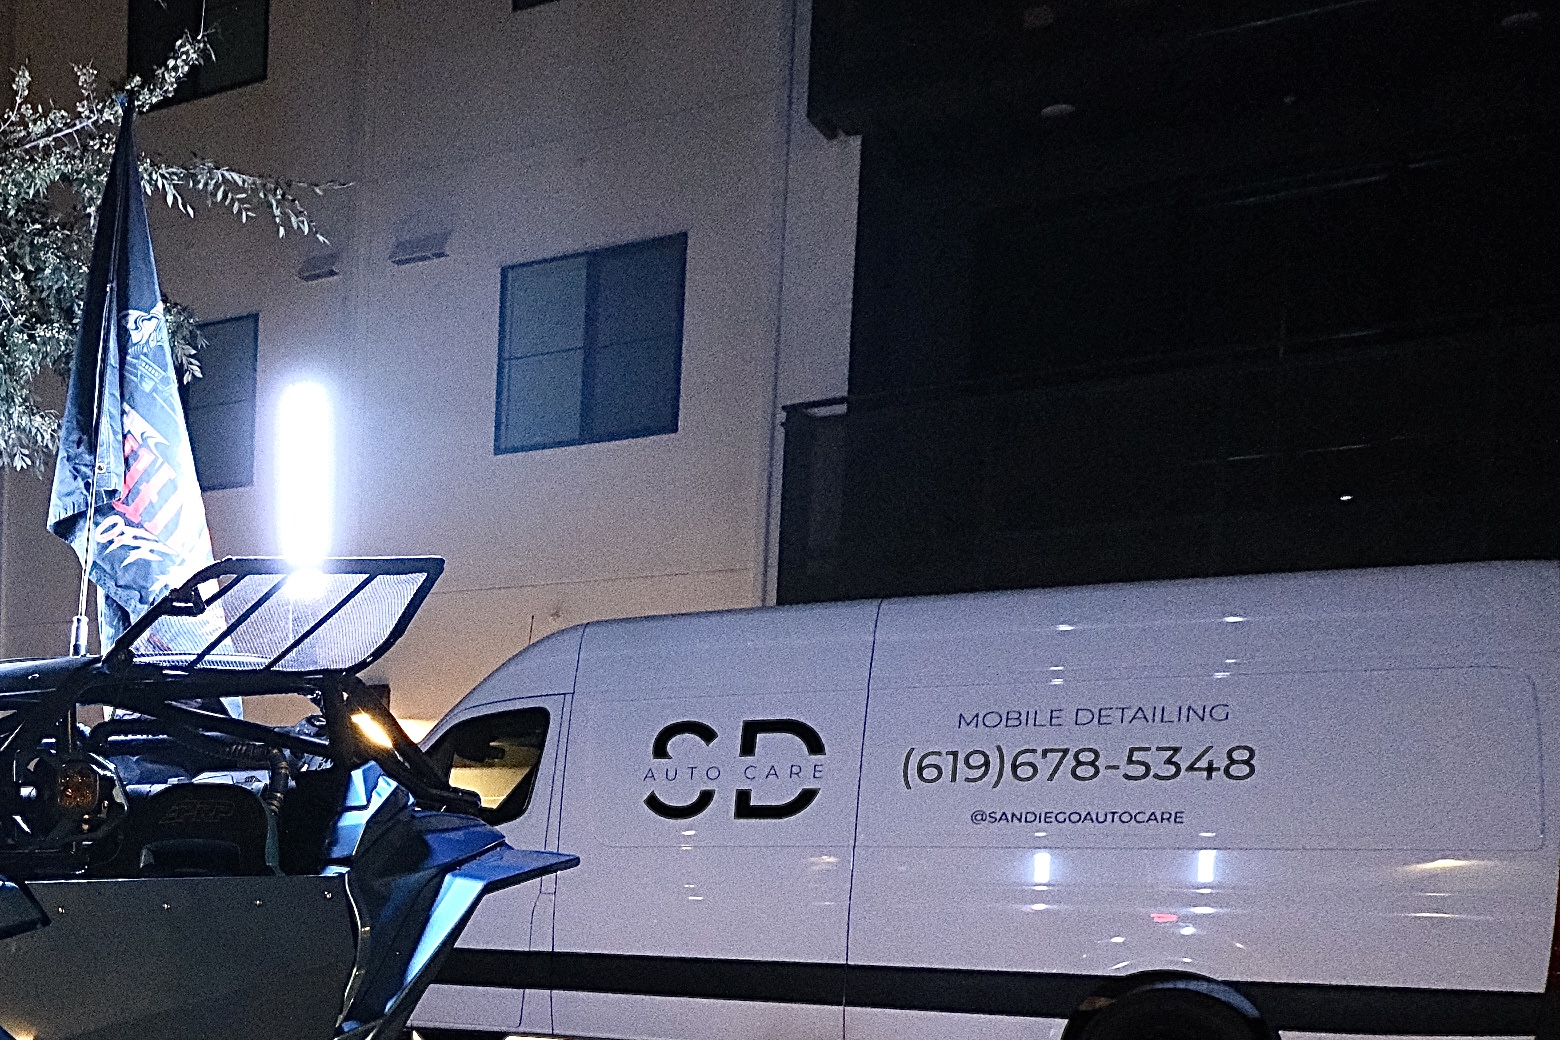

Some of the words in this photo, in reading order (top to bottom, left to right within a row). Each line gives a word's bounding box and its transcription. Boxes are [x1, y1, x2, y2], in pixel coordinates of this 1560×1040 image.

[956, 708, 1064, 730] MOBILE
[1074, 703, 1230, 727] DETAILING
[643, 766, 721, 782] AUTO
[744, 764, 824, 780] CARE
[902, 744, 1256, 790] (619)678-5348
[970, 810, 1186, 826] @SANDIEGOAUTOCARE
